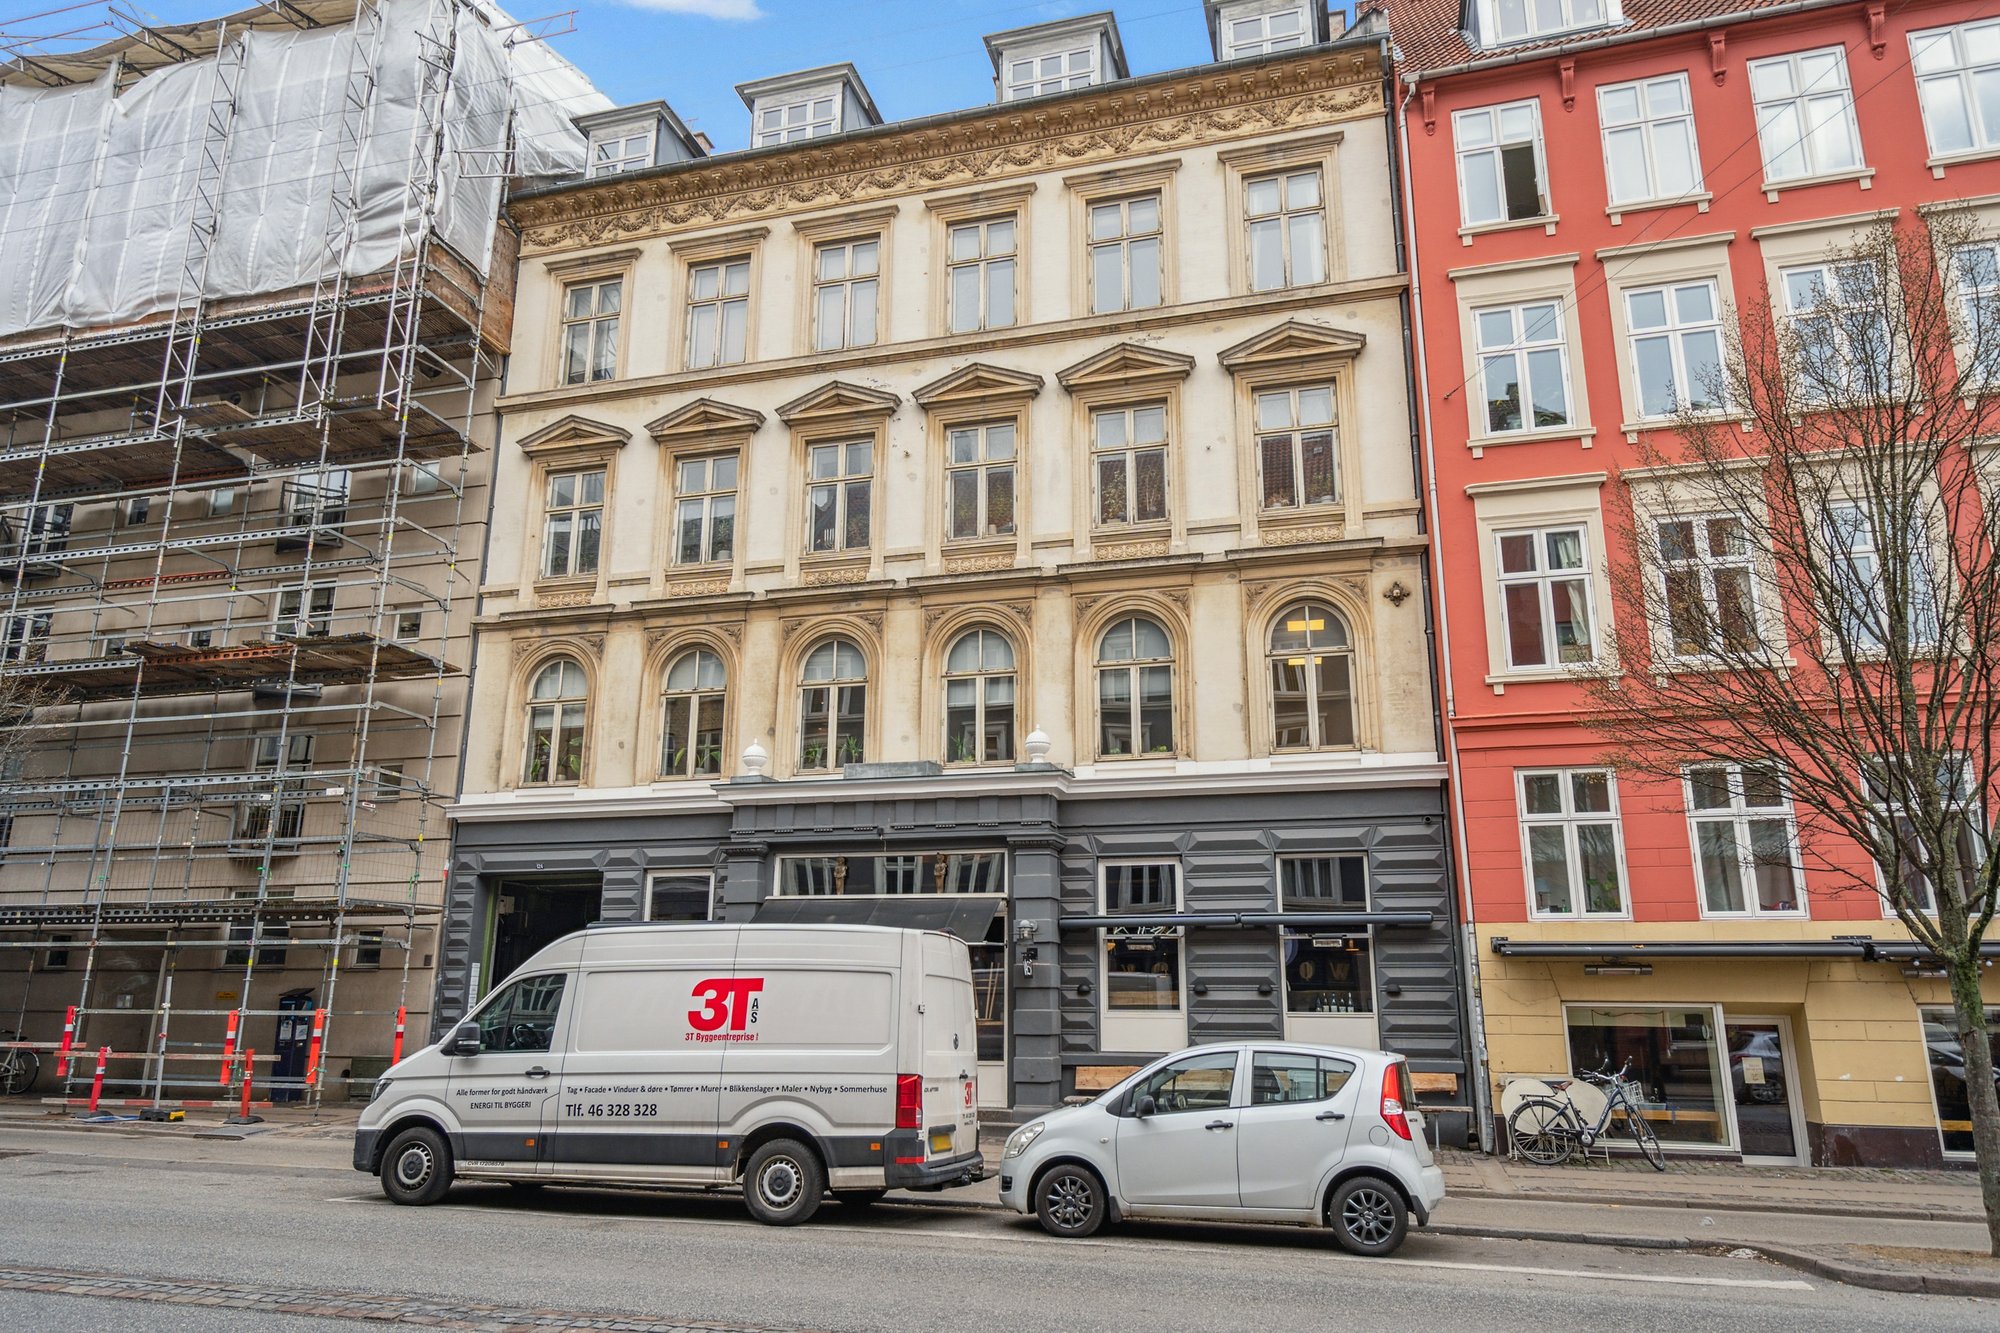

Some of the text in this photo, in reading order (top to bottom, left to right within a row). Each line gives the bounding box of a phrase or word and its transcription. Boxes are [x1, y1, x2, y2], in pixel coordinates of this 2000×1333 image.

[688, 977, 764, 1031] 3T
[685, 1032, 694, 1041] 3T
[696, 1032, 755, 1042] Byggeentreprise
[469, 1088, 490, 1096] former
[501, 1087, 516, 1097] godt
[517, 1086, 548, 1095] håndværk
[566, 1086, 578, 1095] Tag
[613, 1085, 639, 1093] Vinduer
[640, 1085, 646, 1093] &
[647, 1085, 663, 1093] døre
[670, 1085, 693, 1093] Tømrer
[700, 1085, 722, 1093] Murer
[729, 1084, 774, 1094] Blikkenslager
[781, 1085, 802, 1093] Maler
[810, 1085, 832, 1095] Nybyg
[839, 1085, 888, 1093] Sommerhuse
[470, 1101, 531, 1110] ENERGI TIL BYGGERI
[566, 1103, 657, 1117] Tlf. 46 328 328
